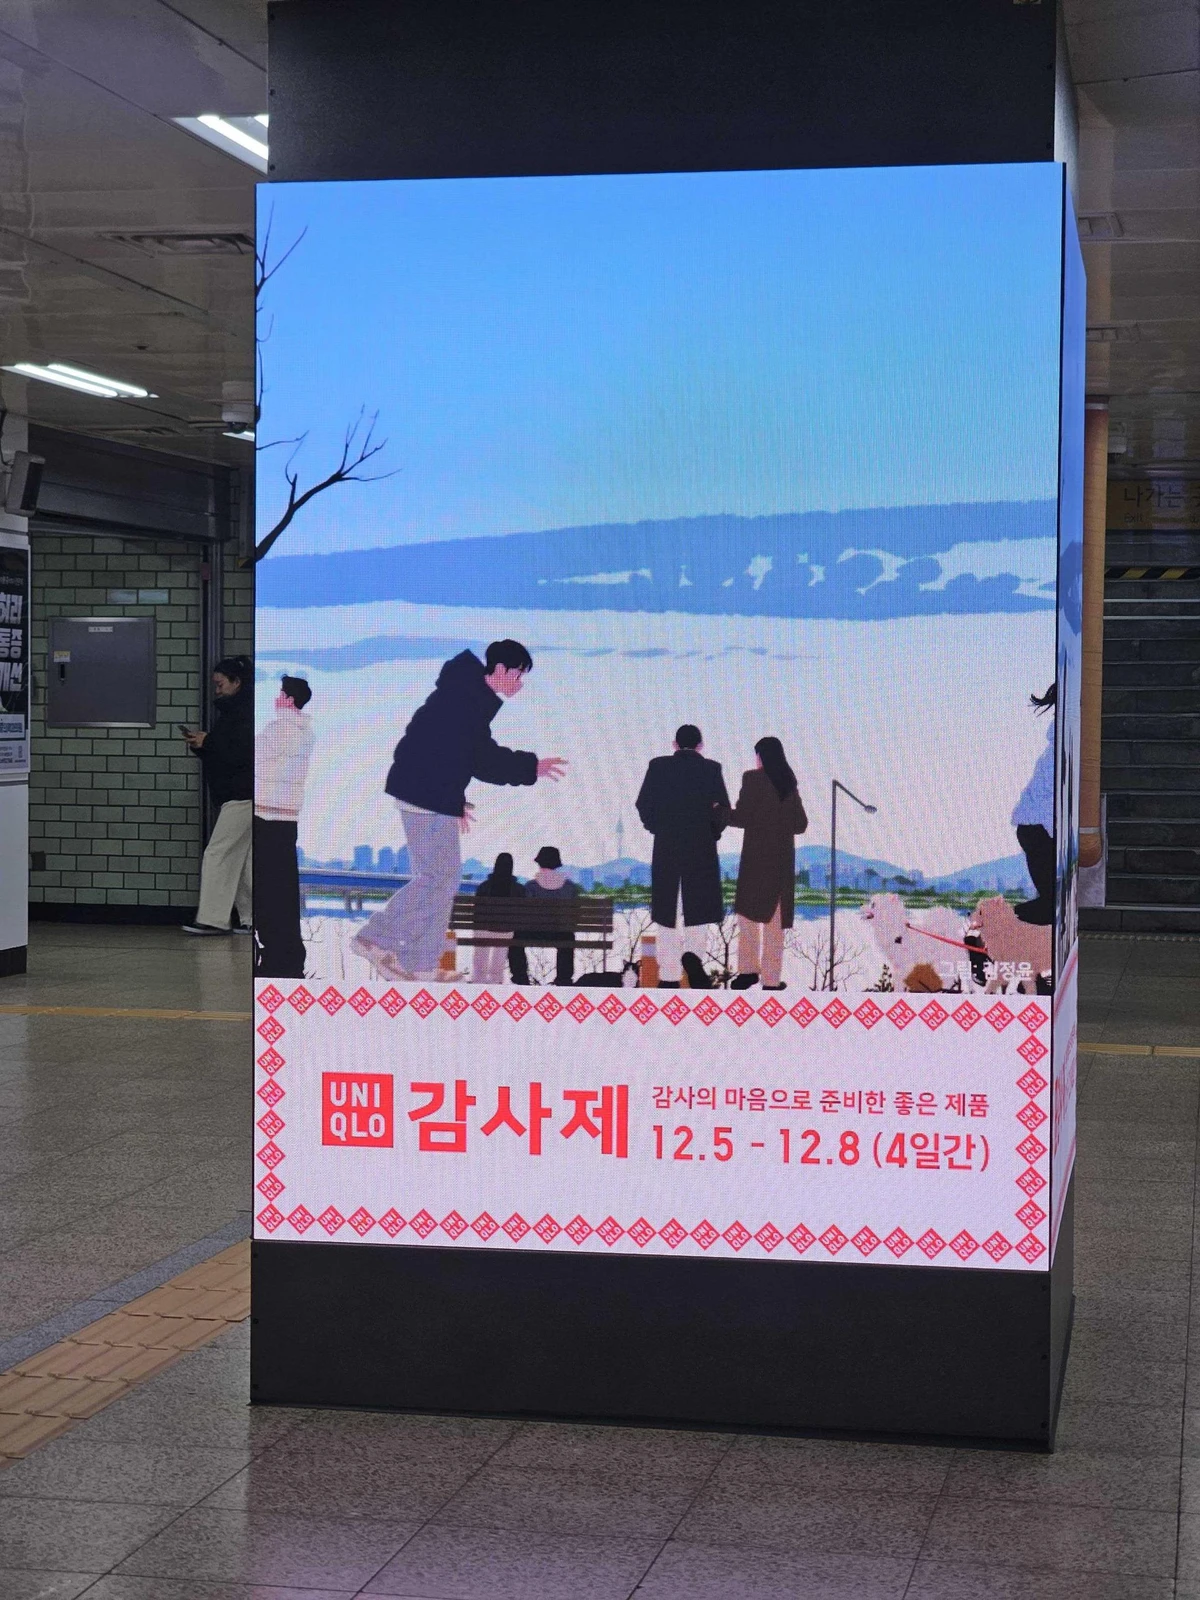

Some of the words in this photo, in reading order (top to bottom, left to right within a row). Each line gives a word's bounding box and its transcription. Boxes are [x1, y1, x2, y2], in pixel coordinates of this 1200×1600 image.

[1123, 485, 1185, 508] 나가는
[259, 988, 275, 1003] UNI
[266, 995, 282, 1010] QLO
[290, 989, 305, 1004] UNI
[297, 996, 312, 1011] QLO
[320, 990, 336, 1005] UNI
[350, 991, 366, 1006] UNI
[381, 992, 397, 1007] UNI
[412, 993, 427, 1008] UNI
[443, 994, 459, 1009] UNI
[474, 995, 490, 1010] UNI
[505, 996, 521, 1011] UNI
[327, 996, 343, 1012] QLO
[357, 997, 373, 1013] QLO
[388, 998, 403, 1013] QLO
[419, 999, 434, 1014] QLO
[450, 1000, 465, 1016] QLO
[481, 1001, 497, 1017] QLO
[513, 1002, 528, 1017] QLO
[537, 997, 553, 1012] UNI
[544, 1003, 560, 1019] QLO
[568, 997, 584, 1013] UNI
[576, 1004, 591, 1019] QLO
[600, 998, 616, 1013] UNI
[607, 1004, 623, 1020] QLO
[632, 999, 648, 1014] UNI
[663, 999, 680, 1015] UNI
[695, 1000, 712, 1016] UNI
[727, 1000, 744, 1016] UNI
[759, 1001, 776, 1017] UNI
[791, 1001, 808, 1017] UNI
[824, 1002, 840, 1018] UNI
[856, 1003, 873, 1019] UNI
[889, 1004, 905, 1019] UNI
[921, 1004, 938, 1020] UNI
[639, 1005, 655, 1021] QLO
[671, 1006, 687, 1022] QLO
[703, 1006, 719, 1022] QLO
[735, 1007, 751, 1023] QLO
[767, 1008, 783, 1023] QLO
[799, 1008, 815, 1024] QLO
[831, 1009, 847, 1025] QLO
[864, 1009, 880, 1025] QLO
[896, 1010, 912, 1026] QLO
[929, 1011, 945, 1027] QLO
[954, 1005, 971, 1021] UNI
[962, 1011, 978, 1027] QLO
[987, 1005, 1004, 1021] UNI
[995, 1012, 1011, 1028] QLO
[1020, 1006, 1037, 1022] UNI
[1028, 1013, 1044, 1029] QLO
[259, 1020, 275, 1035] UNI
[266, 1026, 282, 1041] QLO
[1020, 1039, 1037, 1055] UNI
[1028, 1046, 1044, 1062] QLO
[259, 1051, 275, 1066] UNI
[266, 1057, 282, 1073] QLO
[1019, 1072, 1036, 1088] UNI
[1027, 1079, 1043, 1095] QLO
[259, 1082, 275, 1098] UNI
[266, 1089, 282, 1104] QLO
[330, 1081, 381, 1107] UNI
[652, 1085, 718, 1110] 감사의
[724, 1087, 812, 1112] 마음으로
[820, 1090, 887, 1116] 준비한
[893, 1091, 938, 1117] 좋은
[945, 1093, 990, 1118] 제품
[259, 1113, 275, 1129] UNI
[407, 1079, 629, 1159] 감사제
[1019, 1105, 1036, 1121] UNI
[1027, 1112, 1043, 1128] QLO
[266, 1120, 282, 1135] QLO
[330, 1111, 385, 1141] QLO
[259, 1145, 275, 1160] UNI
[652, 1124, 734, 1163] 12.5
[779, 1128, 861, 1166] 12.8
[872, 1131, 991, 1172] (4일간)
[1019, 1138, 1035, 1154] UNI
[1026, 1145, 1043, 1161] QLO
[266, 1151, 281, 1166] QLO
[259, 1176, 275, 1191] UNI
[1019, 1171, 1035, 1187] UNI
[1026, 1178, 1042, 1194] QLO
[266, 1182, 281, 1198] QLO
[259, 1208, 275, 1223] UNI
[289, 1209, 305, 1224] UNI
[320, 1210, 335, 1225] UNI
[350, 1211, 366, 1226] UNI
[381, 1212, 397, 1227] UNI
[1018, 1204, 1035, 1220] UNI
[1026, 1211, 1042, 1227] QLO
[266, 1214, 281, 1229] QLO
[296, 1215, 311, 1230] QLO
[327, 1216, 342, 1231] QLO
[357, 1217, 373, 1232] QLO
[388, 1218, 403, 1233] QLO
[411, 1213, 427, 1228] UNI
[419, 1219, 434, 1235] QLO
[442, 1214, 458, 1230] UNI
[449, 1221, 465, 1236] QLO
[473, 1216, 489, 1231] UNI
[504, 1217, 520, 1232] UNI
[535, 1218, 551, 1233] UNI
[567, 1219, 583, 1234] UNI
[598, 1220, 614, 1236] UNI
[480, 1222, 496, 1237] QLO
[512, 1223, 527, 1239] QLO
[543, 1224, 558, 1240] QLO
[574, 1226, 590, 1241] QLO
[605, 1227, 621, 1242] QLO
[629, 1221, 646, 1237] UNI
[637, 1228, 652, 1244] QLO
[661, 1223, 677, 1238] UNI
[668, 1229, 684, 1245] QLO
[693, 1224, 709, 1239] UNI
[724, 1225, 741, 1241] UNI
[757, 1226, 773, 1242] UNI
[789, 1227, 805, 1243] UNI
[821, 1229, 838, 1244] UNI
[700, 1230, 716, 1246] QLO
[732, 1232, 748, 1247] QLO
[764, 1233, 780, 1249] QLO
[796, 1234, 812, 1250] QLO
[829, 1235, 845, 1251] QLO
[853, 1230, 870, 1246] UNI
[861, 1237, 877, 1253] QLO
[886, 1231, 903, 1247] UNI
[894, 1238, 910, 1254] QLO
[919, 1232, 935, 1248] UNI
[952, 1234, 968, 1250] UNI
[984, 1235, 1001, 1251] UNI
[1018, 1237, 1035, 1253] UNI
[926, 1239, 942, 1255] QLO
[959, 1241, 975, 1257] QLO
[992, 1242, 1008, 1258] QLO
[1026, 1243, 1042, 1260] QLO
